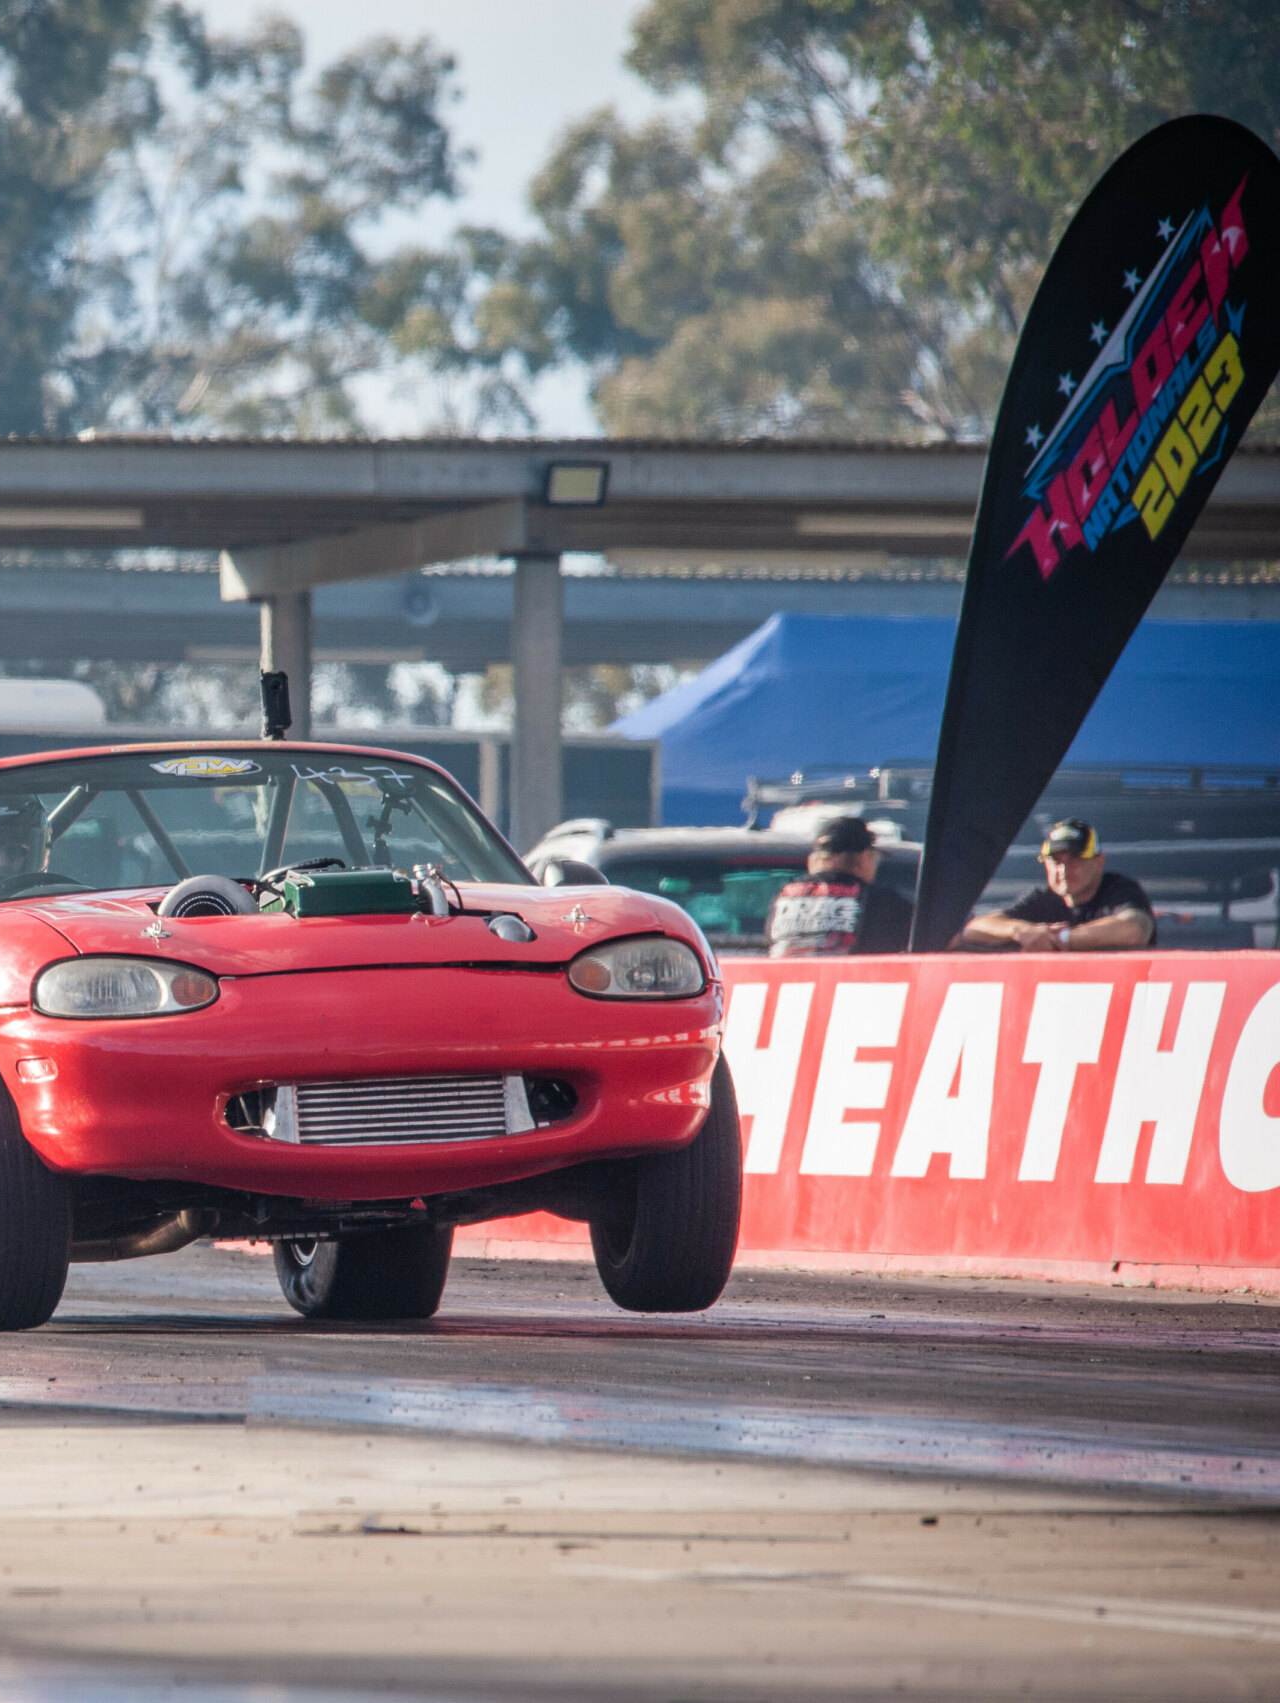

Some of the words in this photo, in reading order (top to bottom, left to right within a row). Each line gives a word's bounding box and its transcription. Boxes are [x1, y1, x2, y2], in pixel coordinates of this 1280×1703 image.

[1004, 171, 1250, 581] HOLDEN
[1082, 313, 1218, 552] NATIONALS
[1132, 332, 1245, 541] 2023
[150, 758, 254, 777] VPW
[774, 897, 861, 919] DRAG
